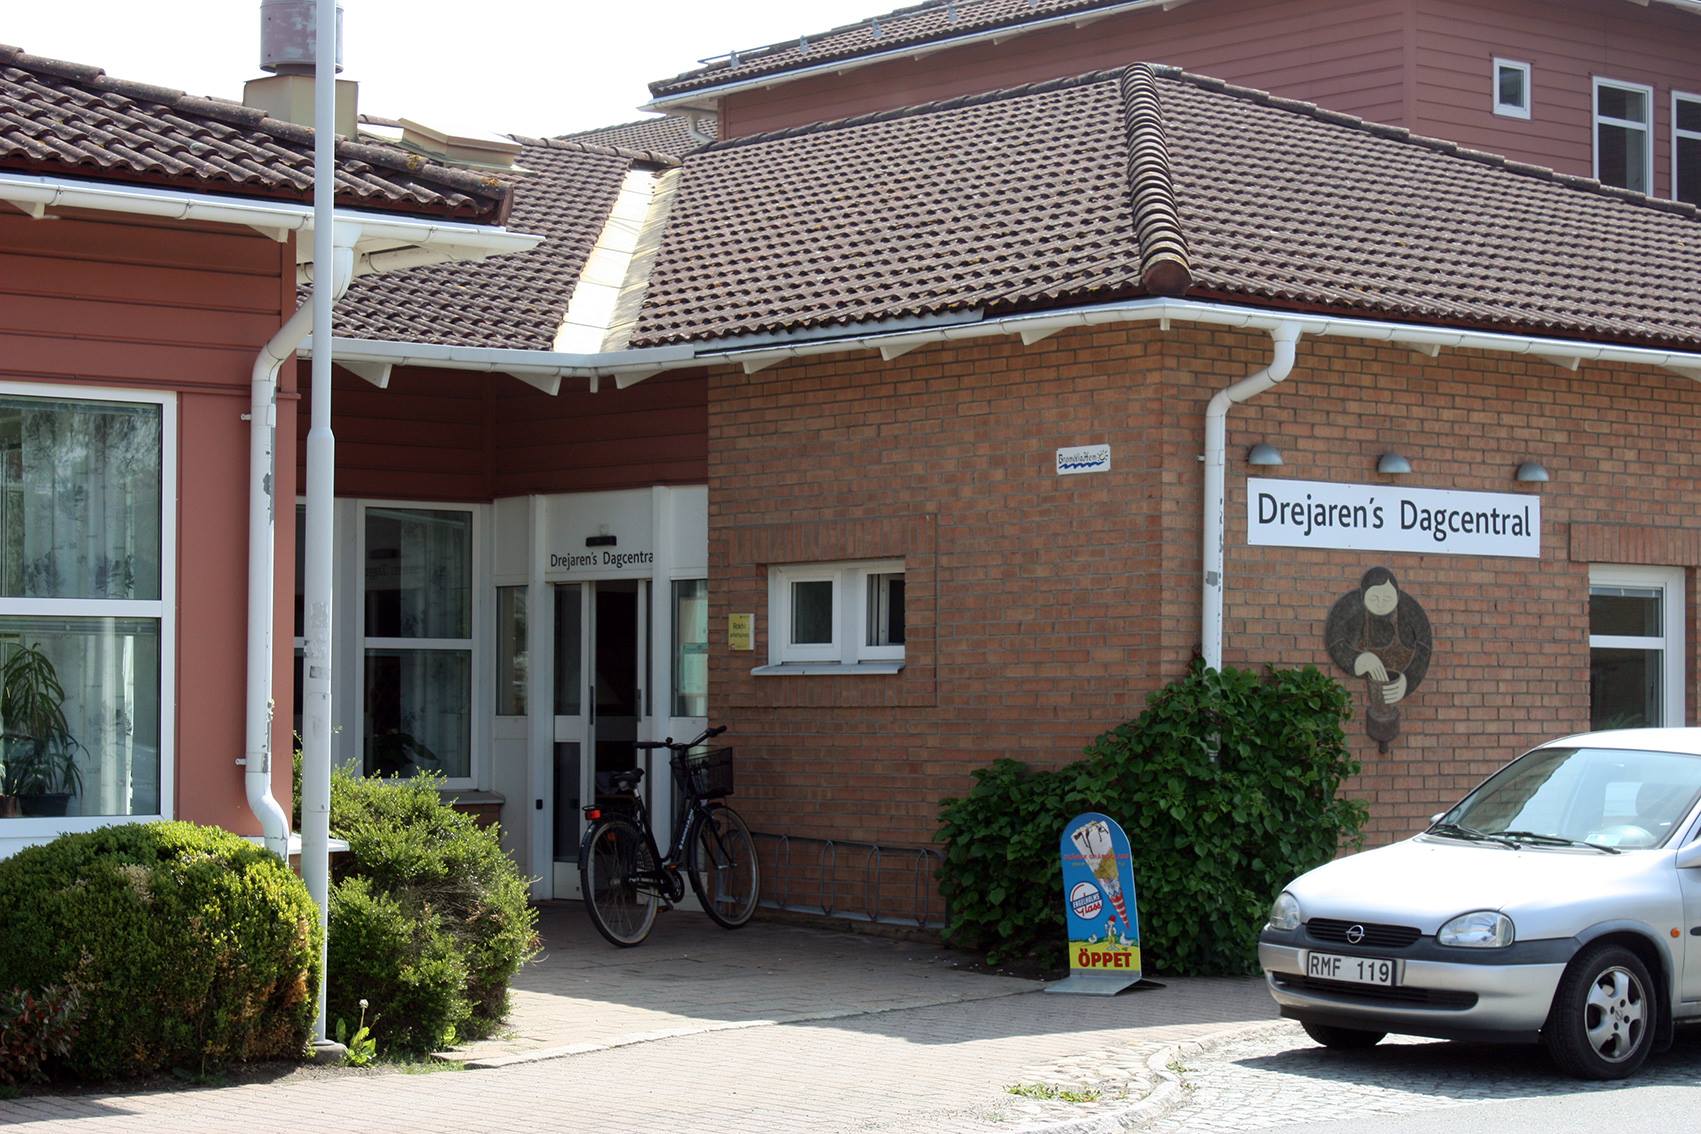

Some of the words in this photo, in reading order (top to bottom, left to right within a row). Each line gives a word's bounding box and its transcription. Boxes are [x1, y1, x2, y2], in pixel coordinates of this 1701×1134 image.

[1400, 499, 1531, 542] Dagcentral
[550, 552, 597, 570] Drejaren's
[1078, 948, 1132, 967] ÖPPET
[1310, 955, 1341, 977] RMF
[1357, 960, 1389, 982] 119
